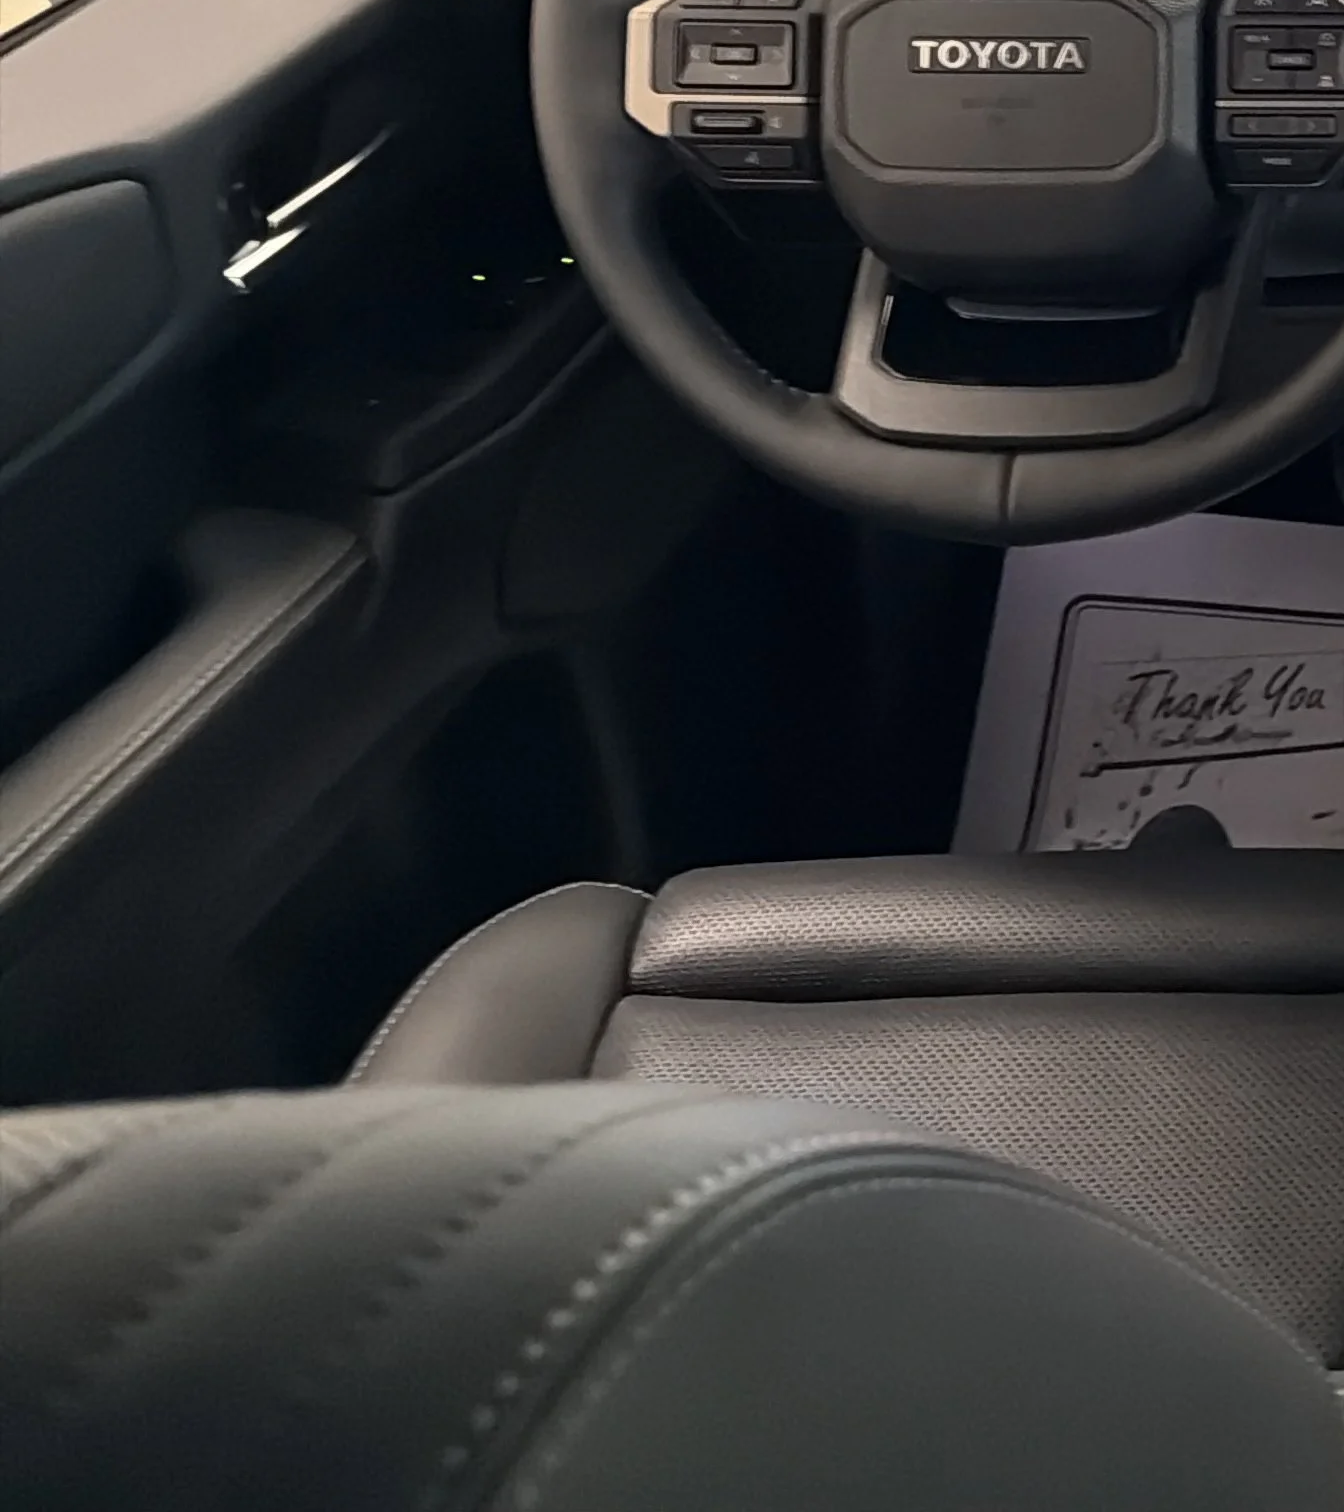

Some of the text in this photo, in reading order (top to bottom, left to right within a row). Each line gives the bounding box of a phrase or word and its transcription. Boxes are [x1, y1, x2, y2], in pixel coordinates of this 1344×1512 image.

[912, 39, 1085, 69] TOYOTA
[1121, 662, 1327, 724] Thank You
